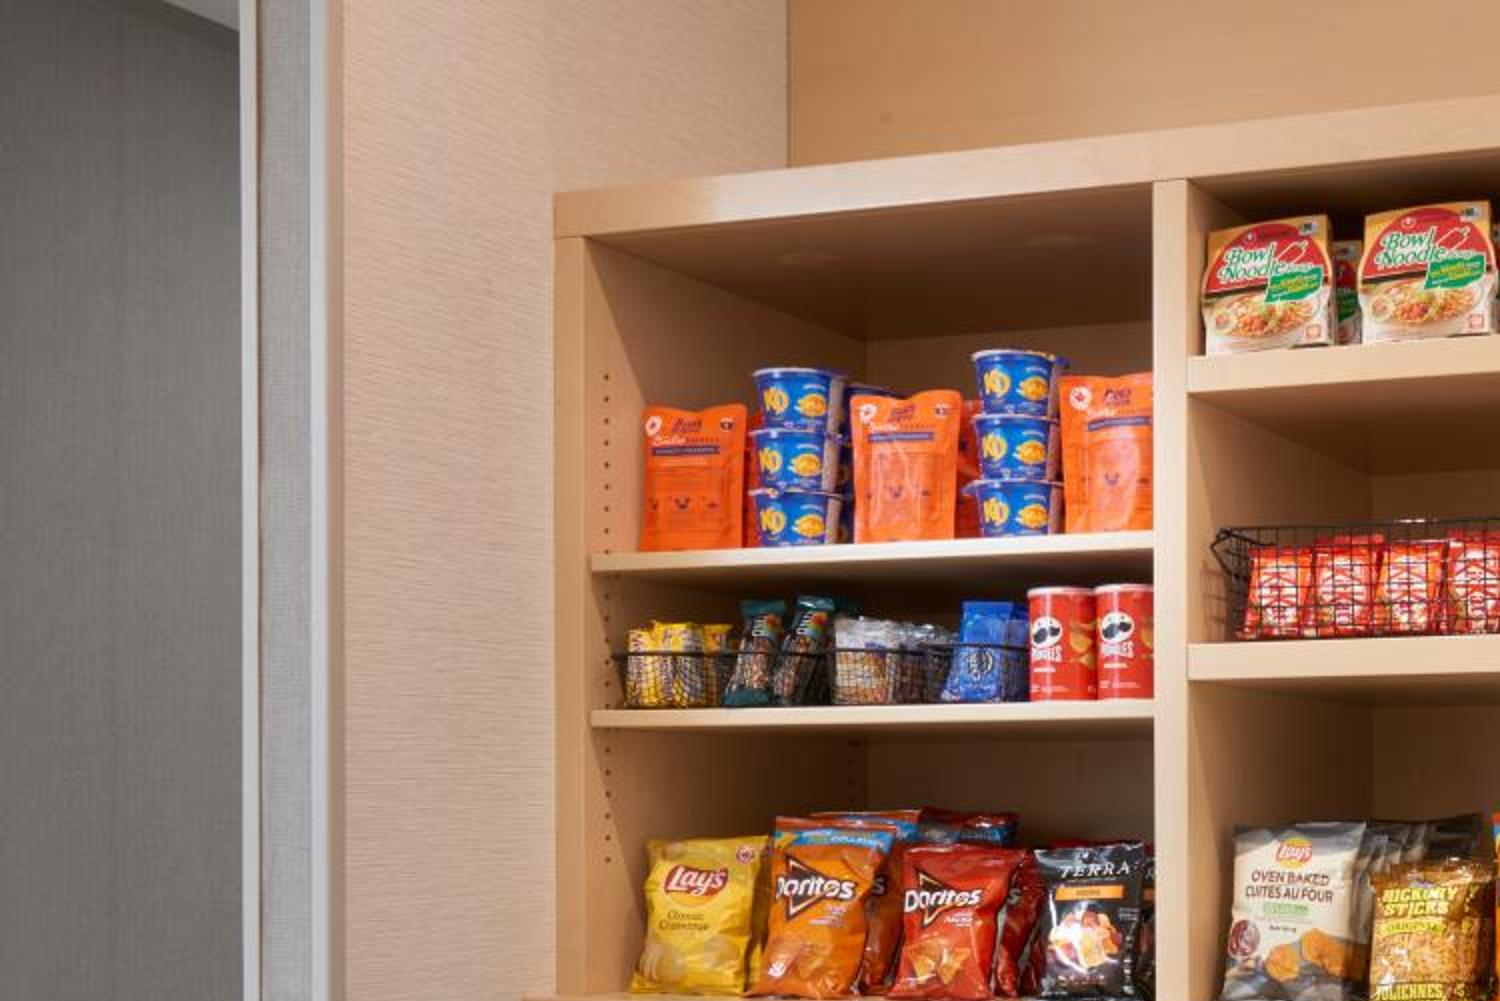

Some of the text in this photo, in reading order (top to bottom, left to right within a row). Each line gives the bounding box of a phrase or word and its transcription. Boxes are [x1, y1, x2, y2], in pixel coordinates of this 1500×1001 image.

[1382, 225, 1436, 251] Bowl
[1226, 241, 1276, 266] Bowl
[1376, 243, 1446, 270] Noodle
[1218, 257, 1290, 283] Noodle
[1059, 860, 1131, 878] TERRA
[1251, 870, 1284, 883] OVEN
[904, 888, 983, 914] Doritos
[1283, 886, 1299, 899] AU
[1301, 889, 1335, 904] FOUR
